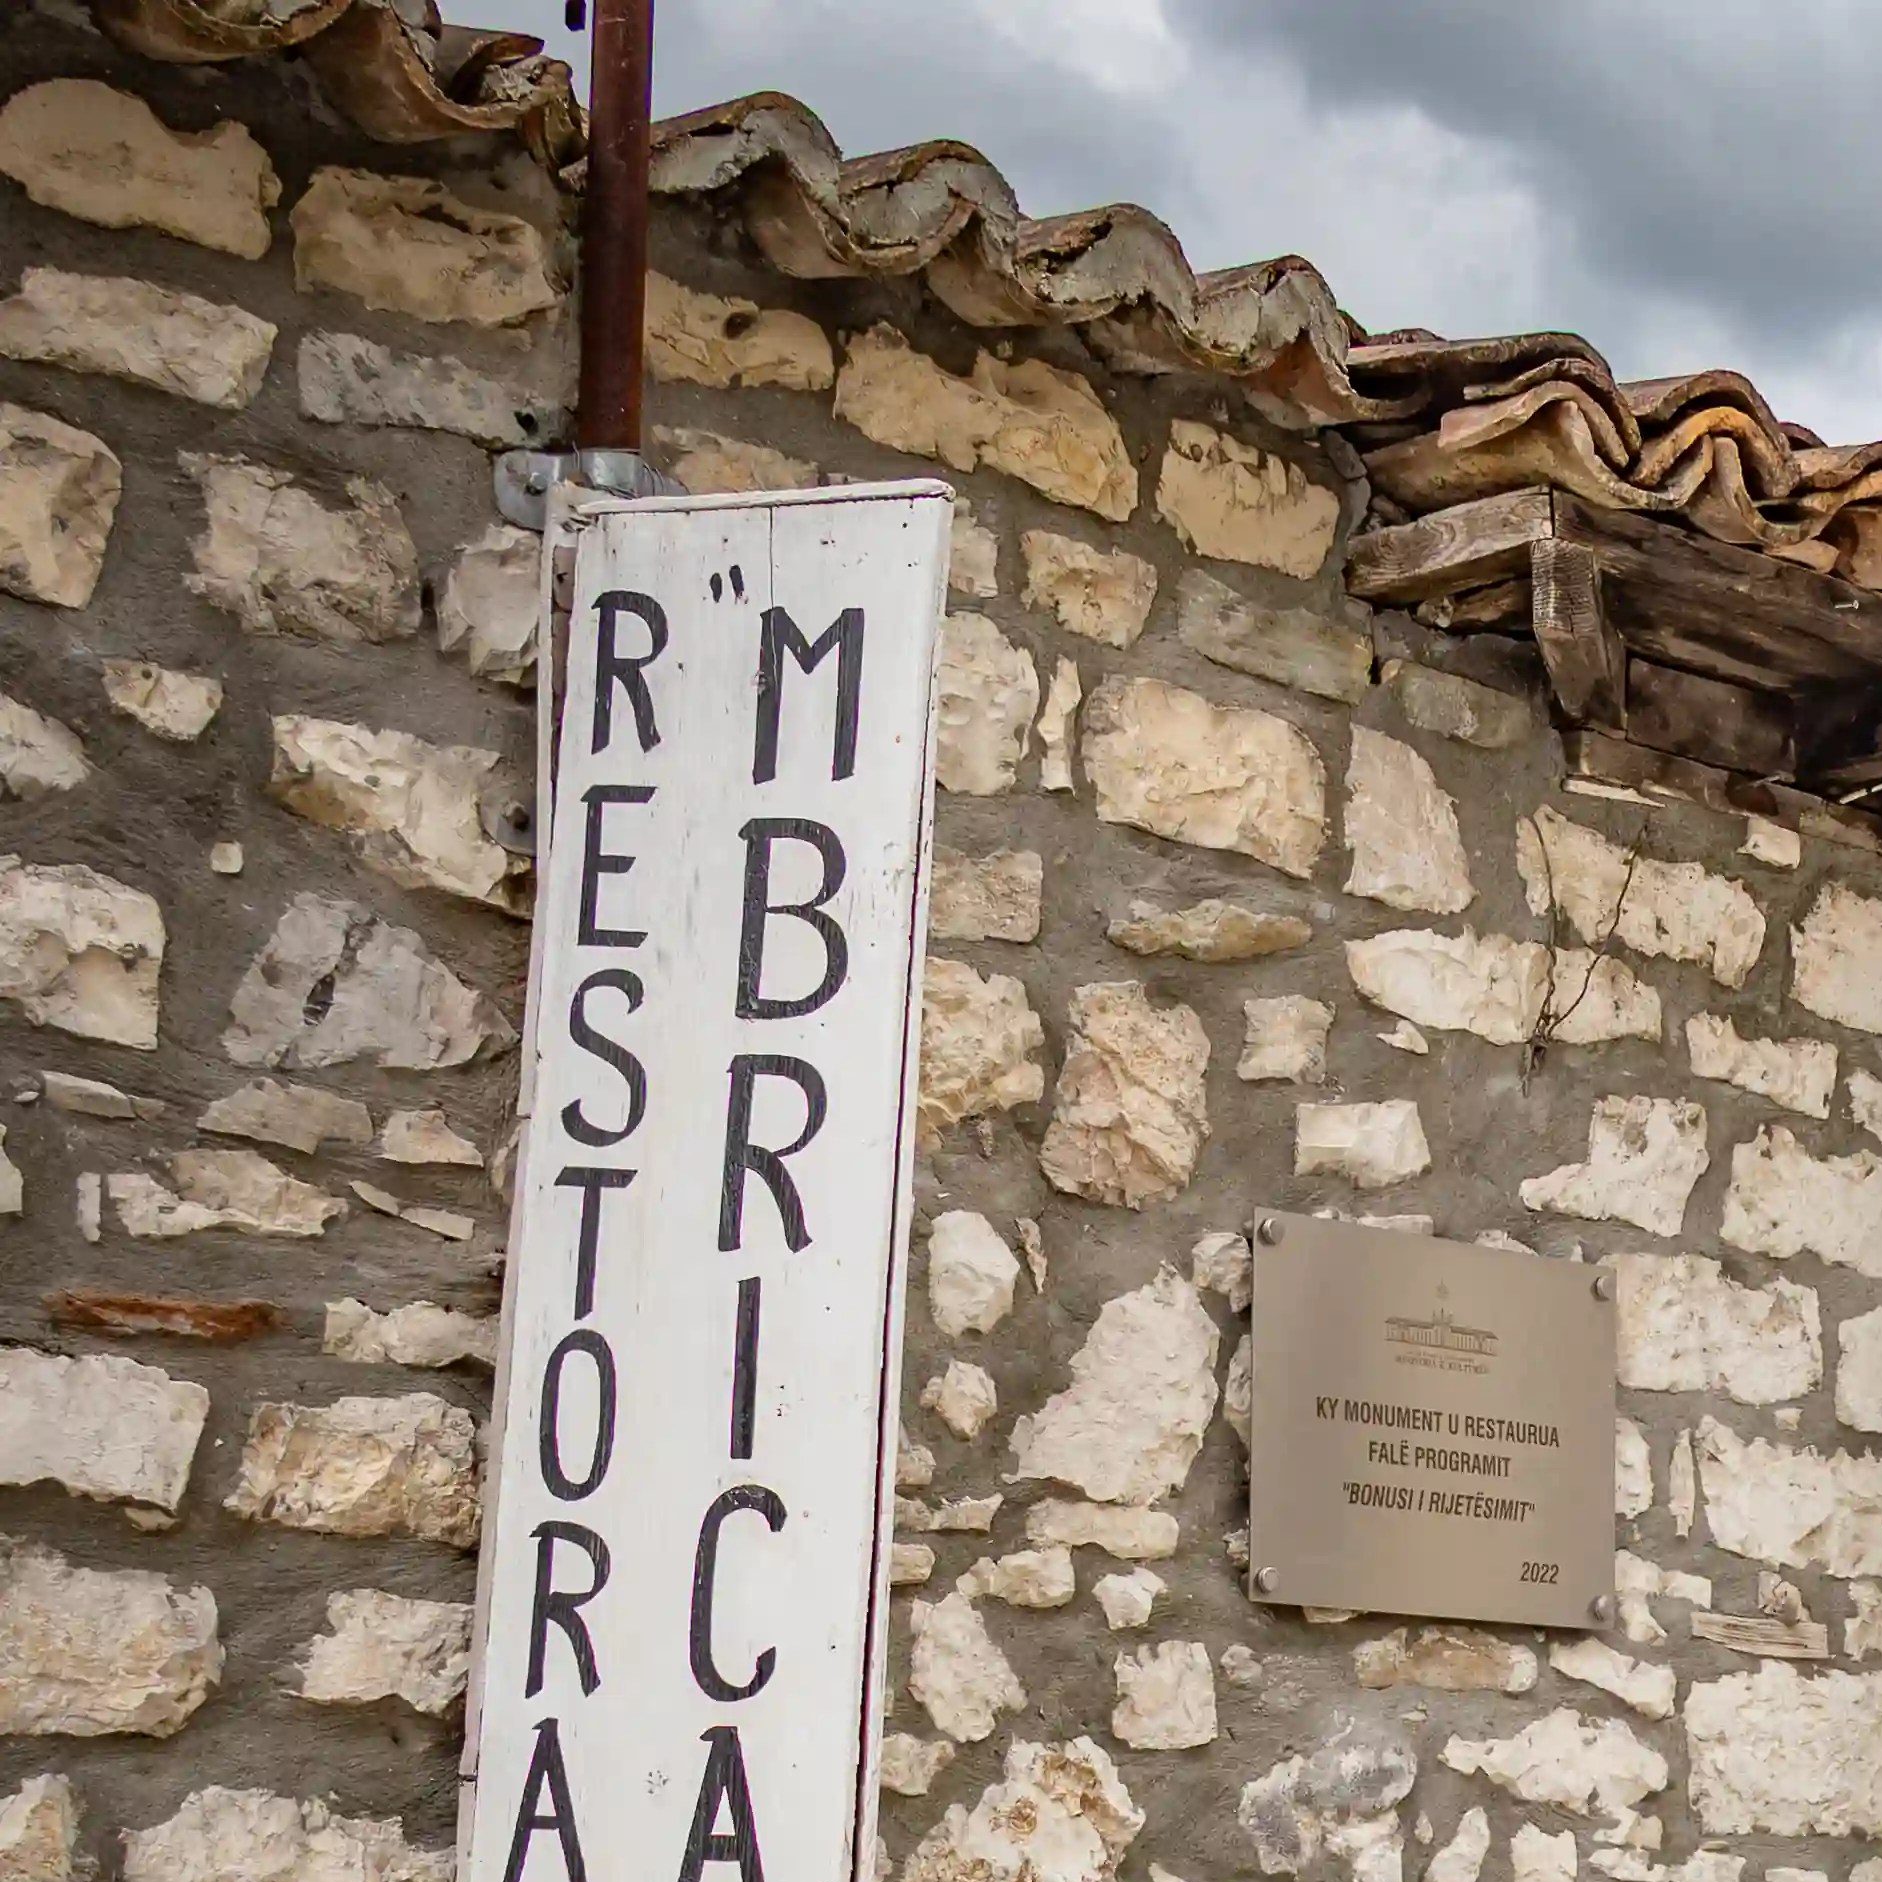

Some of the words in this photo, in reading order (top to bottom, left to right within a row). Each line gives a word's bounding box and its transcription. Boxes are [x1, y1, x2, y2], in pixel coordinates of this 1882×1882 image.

[1315, 1395, 1339, 1422] KY
[1343, 1398, 1443, 1435] MONUMENT
[1447, 1412, 1460, 1436] U
[1464, 1413, 1561, 1449] RESTAURUA
[1368, 1438, 1410, 1467] FALË
[1415, 1446, 1511, 1479] PROGRAMIT
[1342, 1482, 1414, 1511] "BONUSI
[1417, 1489, 1425, 1512] I
[1428, 1490, 1536, 1524] RIJETËSIMIT"
[1519, 1560, 1560, 1586] 2022
